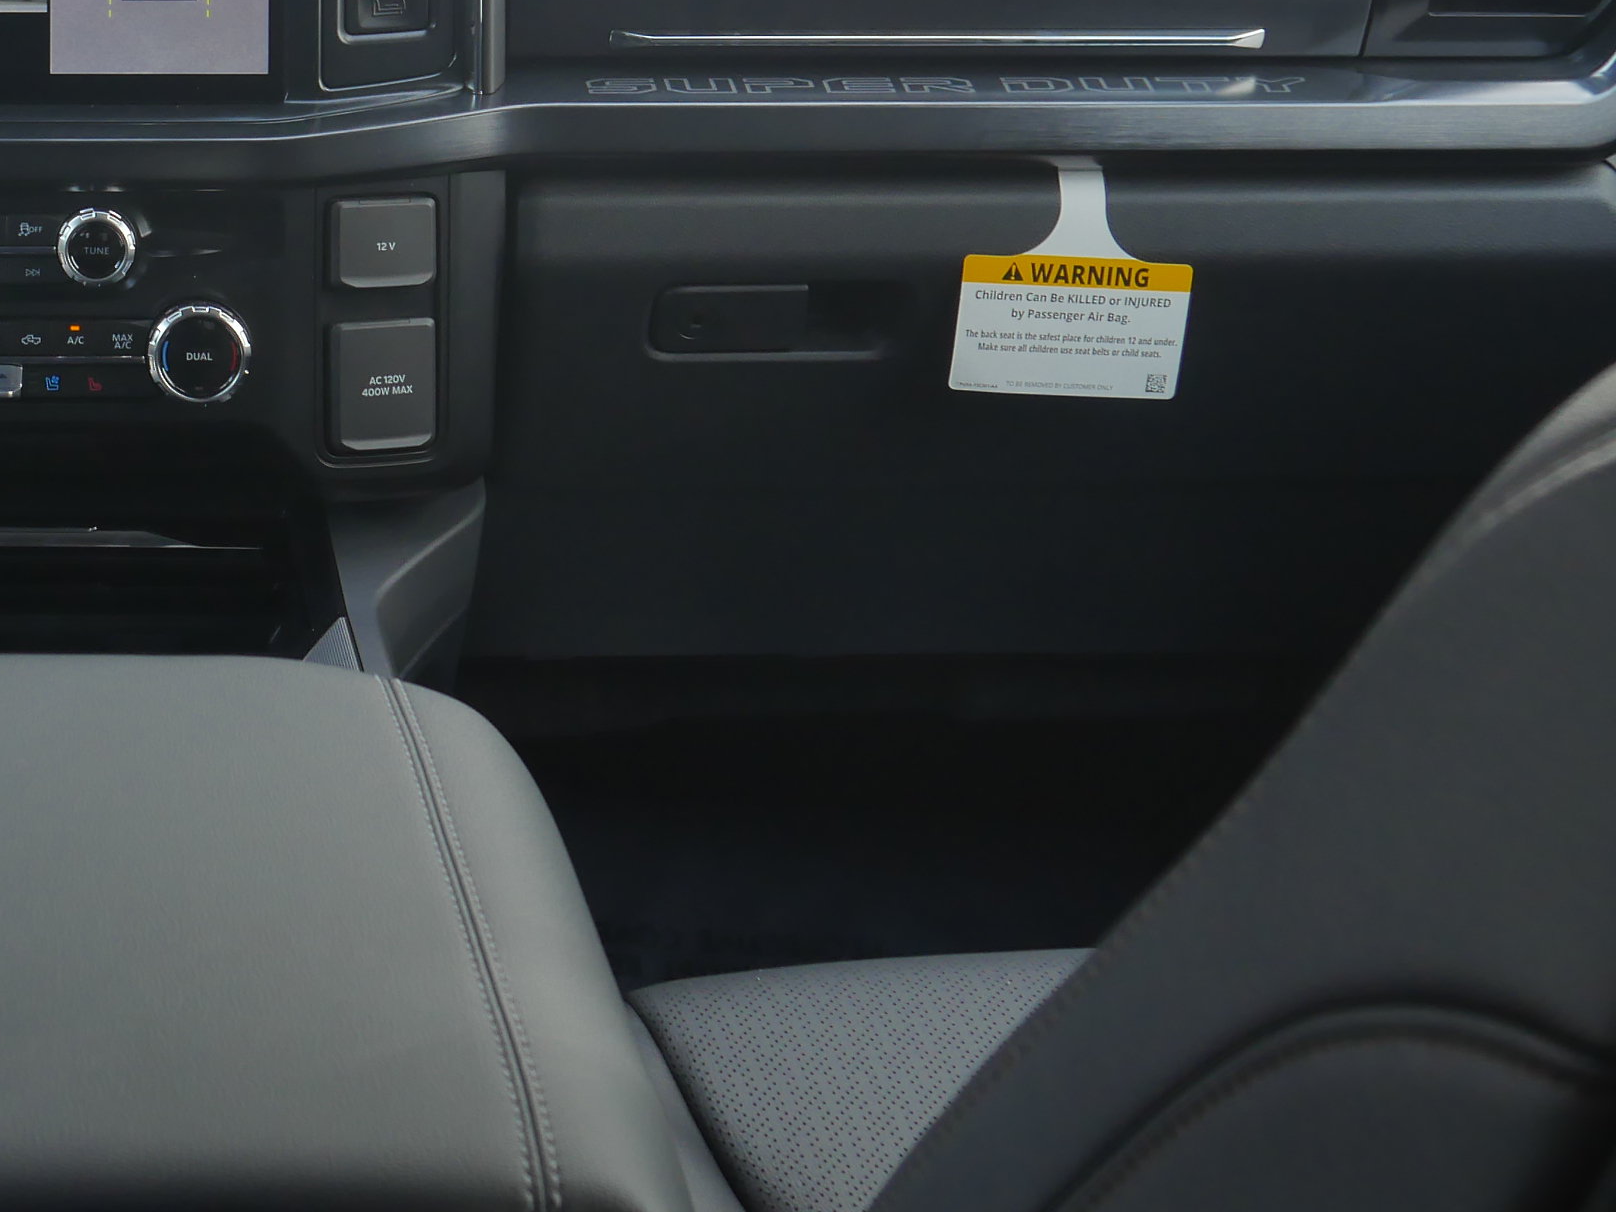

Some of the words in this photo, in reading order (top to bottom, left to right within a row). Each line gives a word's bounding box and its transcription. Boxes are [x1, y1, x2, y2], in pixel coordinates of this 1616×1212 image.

[585, 77, 976, 94] SUPER
[999, 76, 1305, 93] DUTY
[84, 246, 111, 255] TUNE
[376, 242, 387, 251] 12
[389, 242, 396, 251] V
[1030, 262, 1150, 287] WARNING
[975, 290, 1023, 302] Children
[1026, 292, 1047, 302] Can
[1050, 293, 1065, 303] Be
[1067, 294, 1106, 305] KILLED
[1109, 297, 1122, 305] or
[1124, 296, 1172, 308] INJURED
[1011, 308, 1025, 320] by
[1028, 309, 1085, 322] Passenger
[1087, 311, 1104, 321] Air
[1107, 312, 1131, 325] Bag.
[67, 336, 84, 345] A/C
[112, 334, 133, 342] MAX
[965, 329, 979, 338] The
[980, 330, 998, 339] back
[999, 331, 1015, 340] seat
[1017, 332, 1023, 340] is
[1025, 332, 1037, 340] the
[1039, 332, 1061, 341] safest
[1062, 333, 1081, 343] place
[1083, 334, 1094, 343] for
[1096, 335, 1125, 344] children
[1128, 336, 1136, 345] 12
[1138, 337, 1152, 345] and
[1154, 338, 1178, 347] under.
[114, 341, 132, 350] A/C
[977, 343, 998, 351] Make
[1000, 344, 1016, 352] sure
[1017, 344, 1027, 352] all
[1028, 344, 1059, 354] children
[1092, 347, 1110, 356] belts
[1121, 349, 1139, 357] child
[1140, 350, 1162, 358] seats.
[186, 352, 213, 361] DUAL
[369, 376, 382, 385] AC
[383, 374, 406, 384] 120V
[361, 386, 391, 397] 400W
[392, 385, 413, 395] MAX
